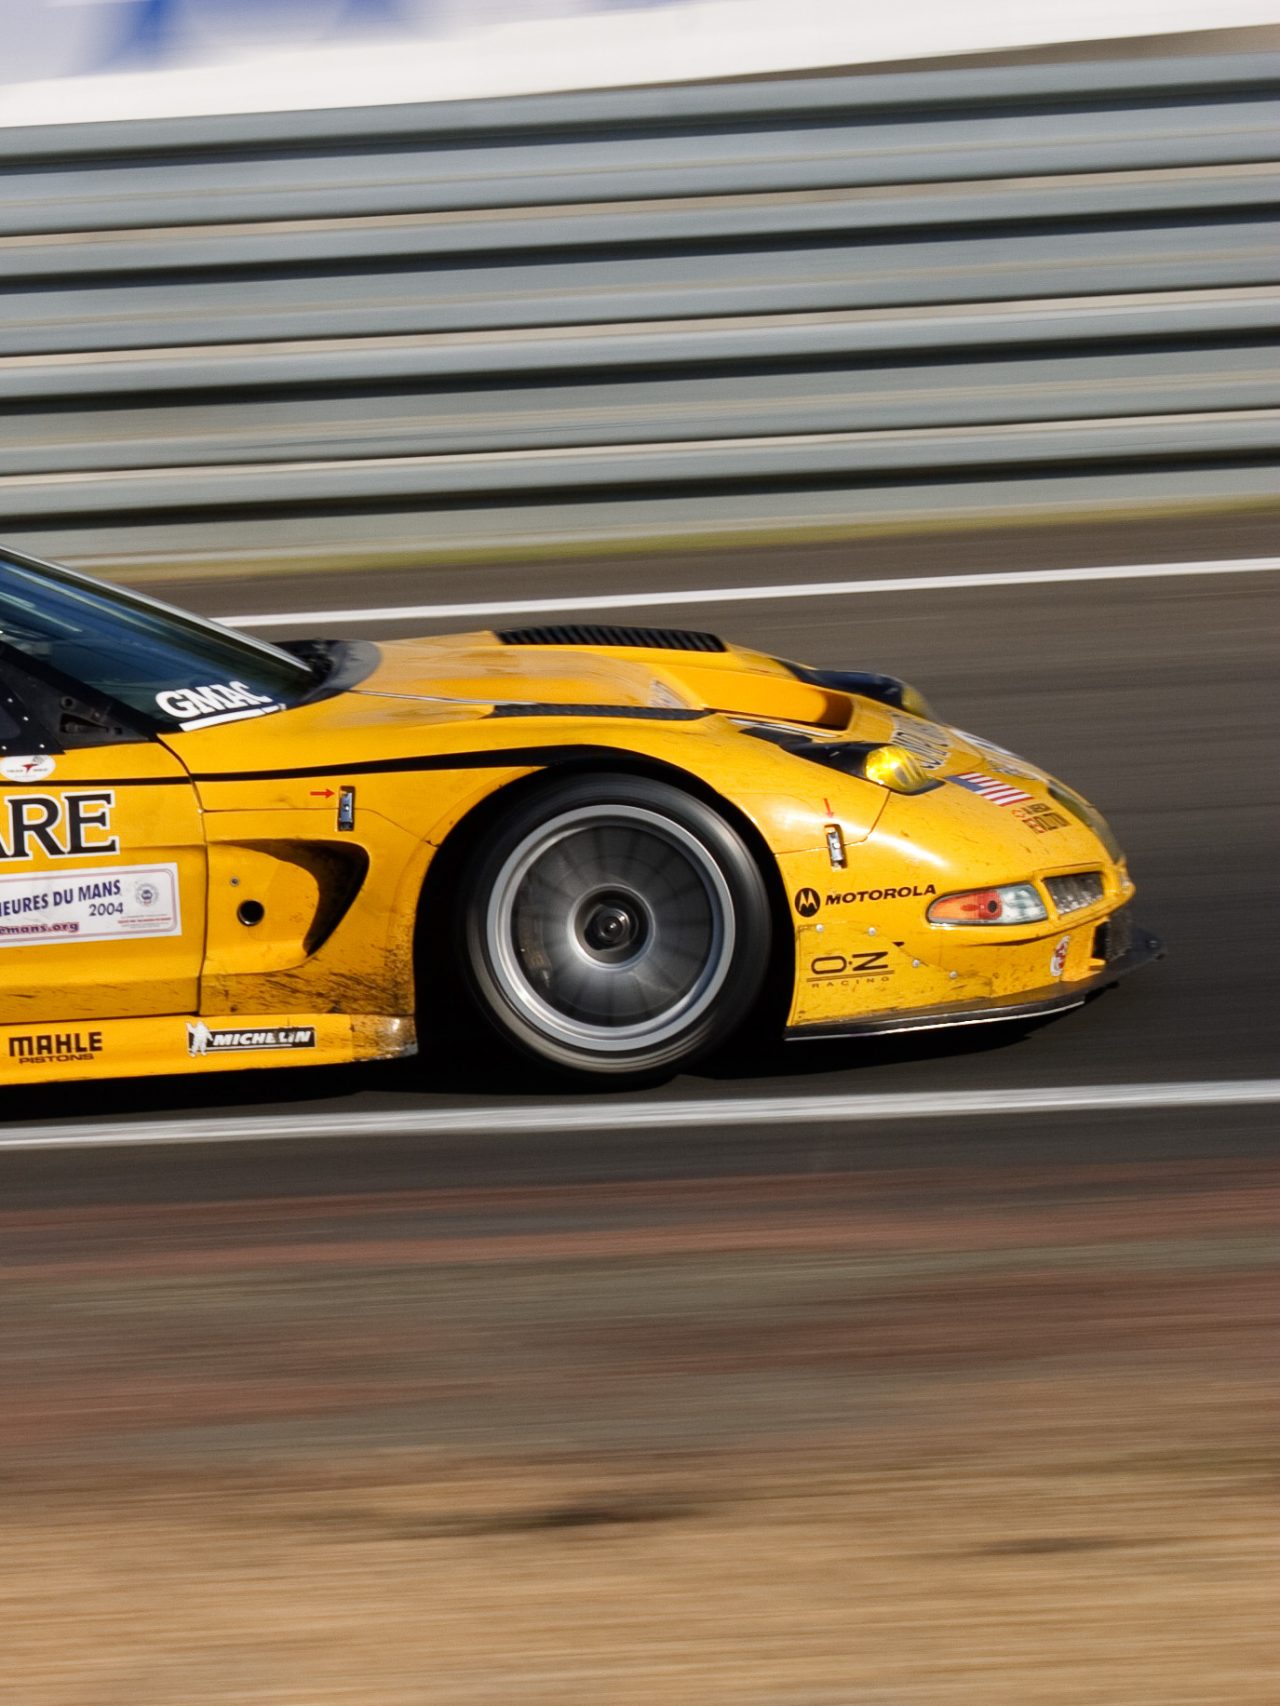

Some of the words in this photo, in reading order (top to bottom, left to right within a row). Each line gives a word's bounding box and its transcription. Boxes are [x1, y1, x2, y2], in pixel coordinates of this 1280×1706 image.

[155, 681, 273, 718] GMAC
[53, 888, 74, 906] DU
[78, 879, 121, 901] MANS
[825, 884, 936, 906] MOTOROLA
[89, 902, 124, 917] 2004
[811, 976, 890, 988] RACING
[9, 1031, 103, 1057] MAHLE
[213, 1030, 312, 1047] MICHELIN
[19, 1053, 95, 1065] PISTONS
